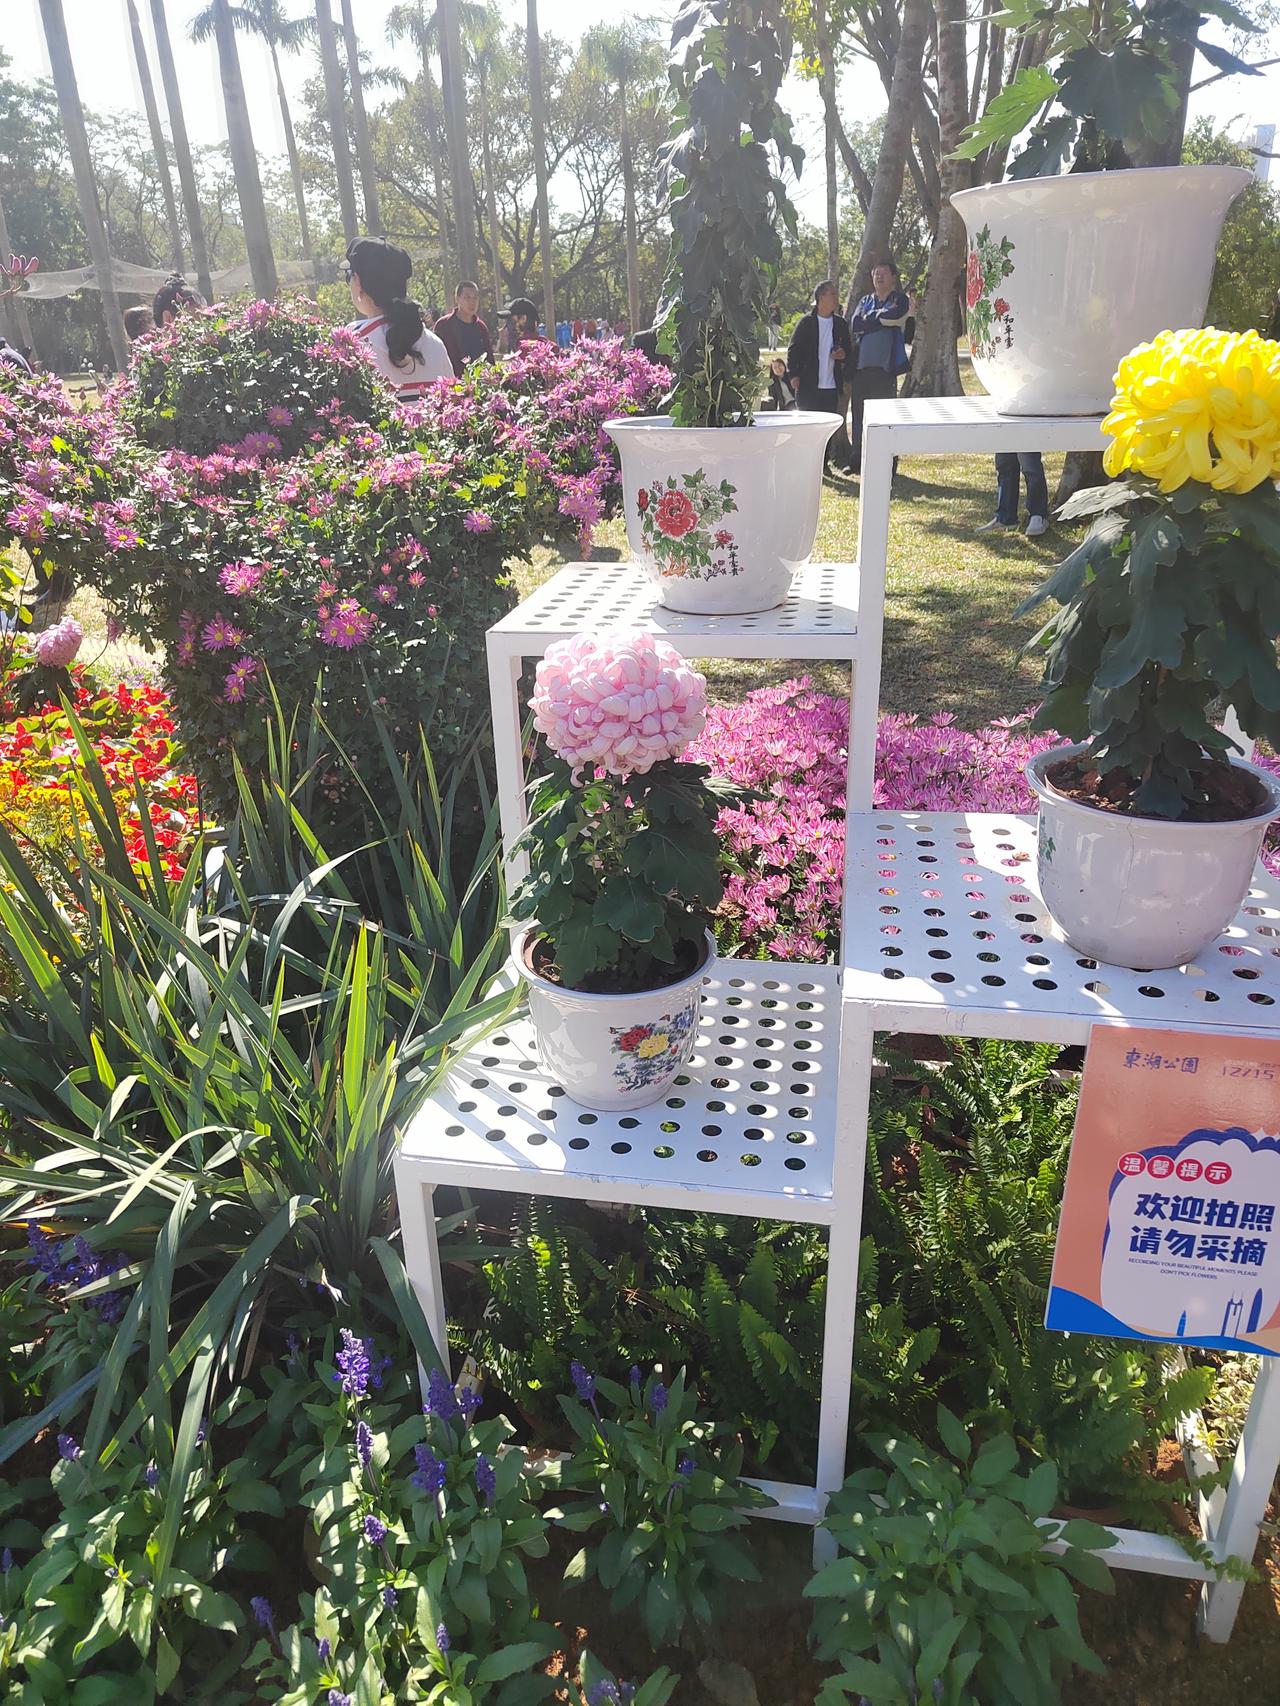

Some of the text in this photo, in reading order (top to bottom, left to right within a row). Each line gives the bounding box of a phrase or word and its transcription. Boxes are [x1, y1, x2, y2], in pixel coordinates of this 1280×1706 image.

[1123, 1157, 1227, 1181] 温馨提示
[1134, 1192, 1276, 1232] 欢迎拍照
[1129, 1225, 1268, 1266] 请勿采摘
[1177, 1263, 1206, 1271] BEAUTIFUL
[1208, 1266, 1236, 1274] MOMENTS
[1191, 1272, 1218, 1280] FLOWERS
